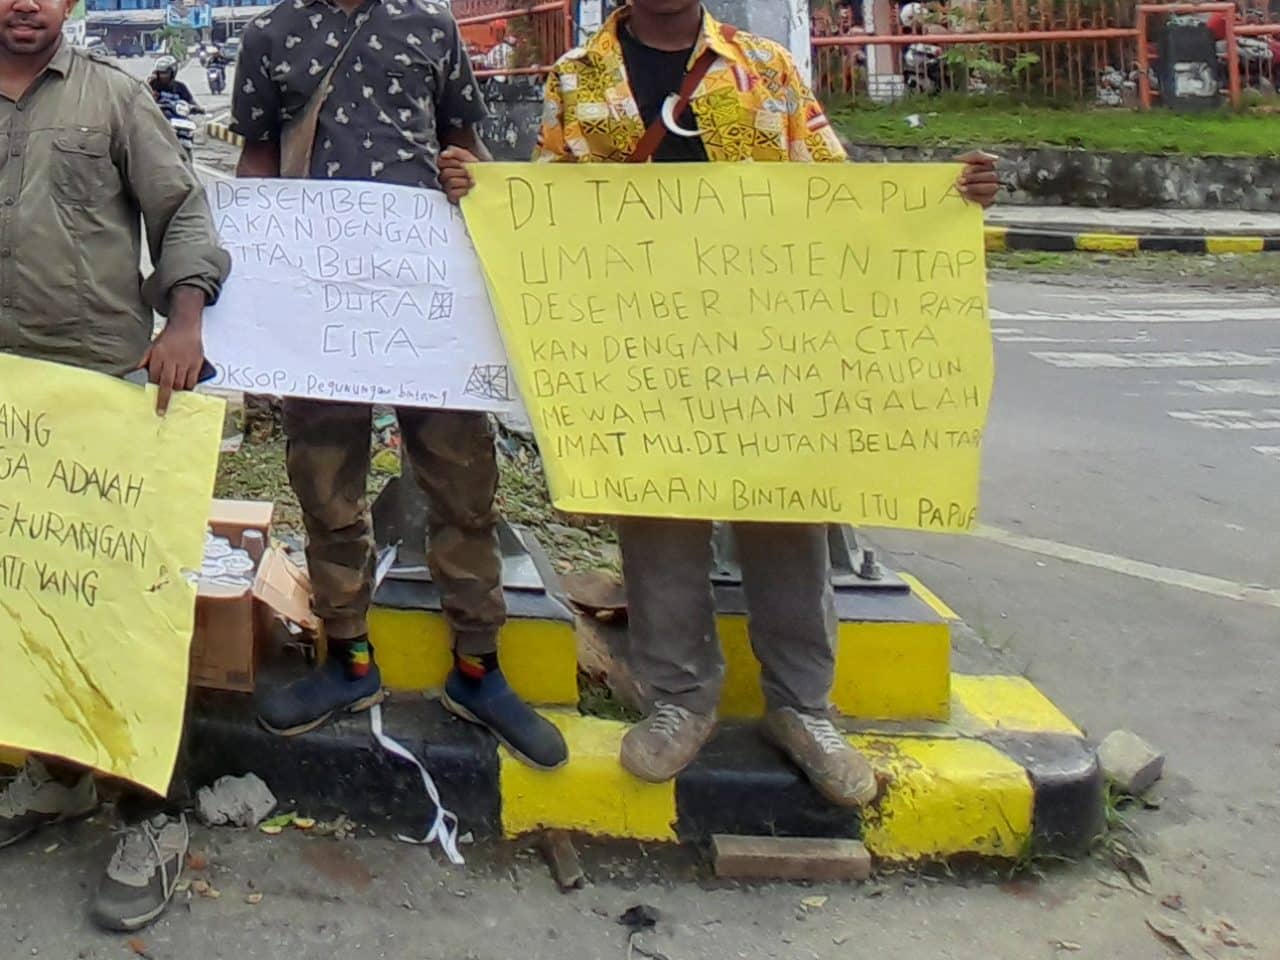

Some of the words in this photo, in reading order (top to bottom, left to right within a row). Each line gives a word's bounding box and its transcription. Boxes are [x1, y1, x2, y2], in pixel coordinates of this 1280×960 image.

[215, 179, 401, 221] DESEMBER
[412, 192, 435, 221] DI
[506, 176, 557, 231] DI
[584, 174, 775, 225] TANAH
[806, 175, 970, 220] PAPUA
[219, 213, 314, 239] AKAN
[326, 216, 449, 248] DENGAN
[316, 244, 448, 283] BUKAN
[520, 239, 656, 285] UMAT
[693, 236, 870, 280] KRISTEN
[891, 248, 978, 283] TIAP
[323, 283, 425, 319] DUKA
[520, 288, 721, 326] DESEMBER
[749, 287, 856, 315] NATAL
[871, 290, 899, 319] DI
[919, 291, 986, 319] RAYA
[322, 323, 420, 358] CITA
[530, 337, 589, 363] KAN
[602, 330, 739, 364] DENGAN
[758, 326, 841, 354] SUKA
[855, 324, 940, 355] CITA
[533, 367, 612, 399] BAIK
[840, 355, 962, 385] MAUPUN
[680, 392, 796, 425] TUHAN
[738, 431, 839, 457] HUTAN
[731, 477, 843, 513] BINTANG
[859, 491, 899, 522] ITU
[33, 559, 100, 608] YANG
